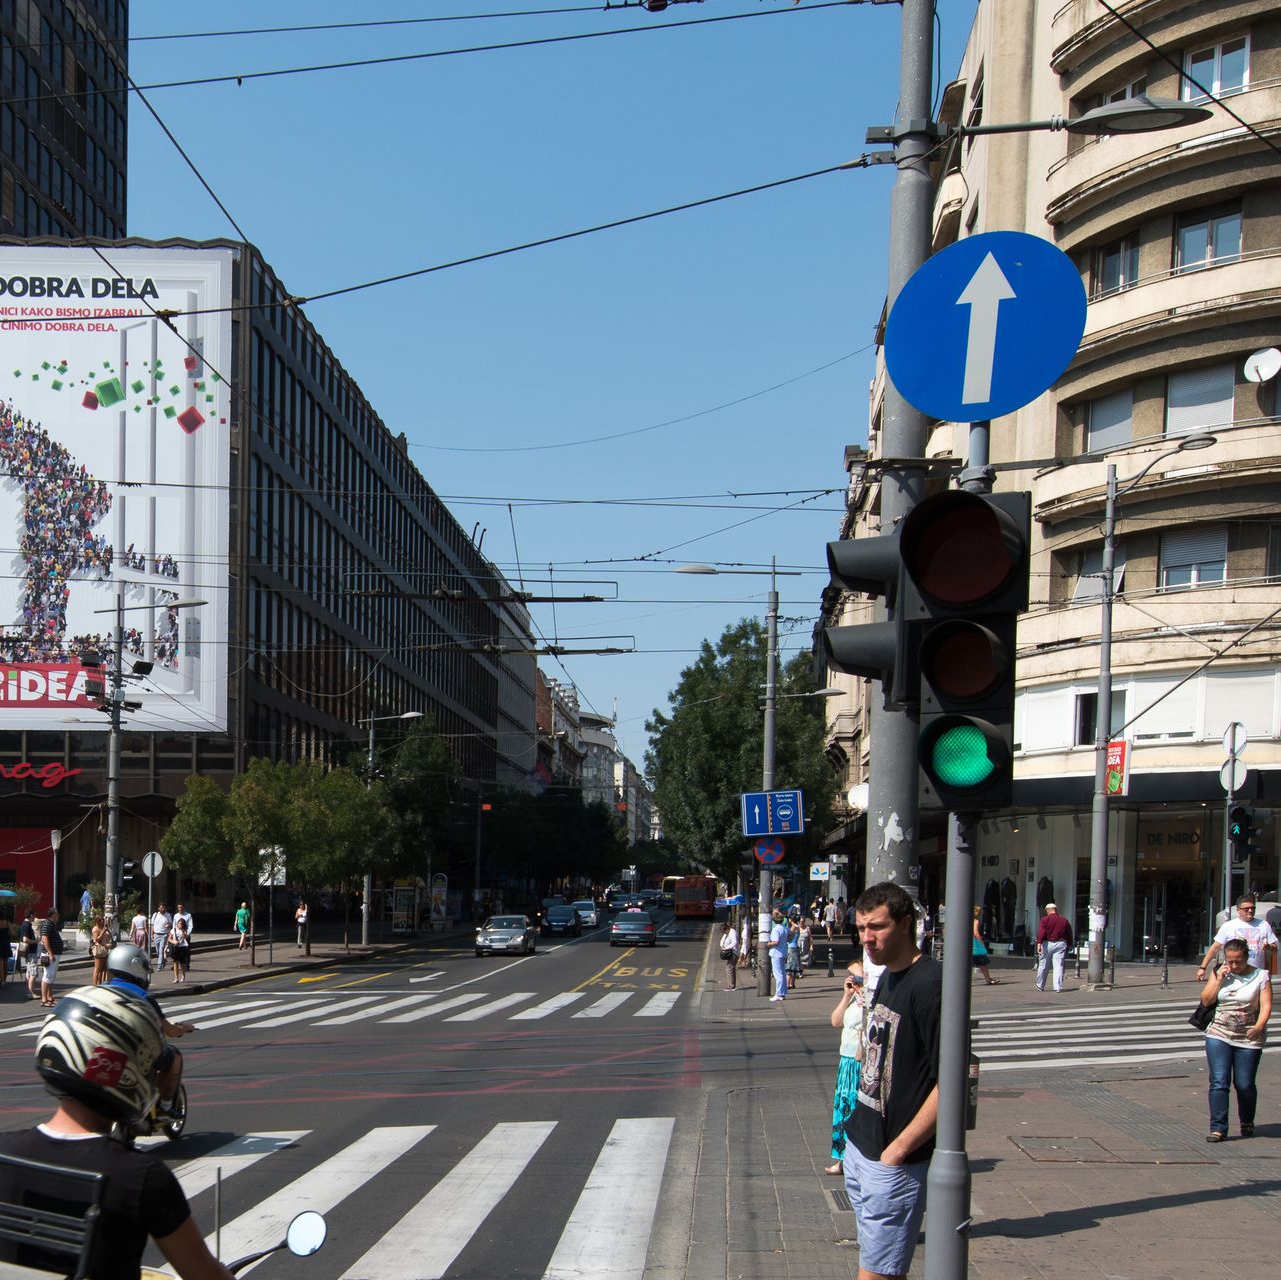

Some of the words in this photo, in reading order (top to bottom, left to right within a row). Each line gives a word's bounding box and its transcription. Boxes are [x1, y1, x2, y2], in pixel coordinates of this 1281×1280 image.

[91, 277, 160, 299] DELA
[20, 306, 52, 317] KAKO
[55, 307, 92, 317] BISMO
[0, 318, 43, 331] ČINIMO
[44, 322, 85, 332] DOBRA
[87, 322, 118, 333] DELA.
[1147, 832, 1163, 846] DE
[1167, 831, 1200, 846] NIRO
[613, 967, 689, 978] BUS
